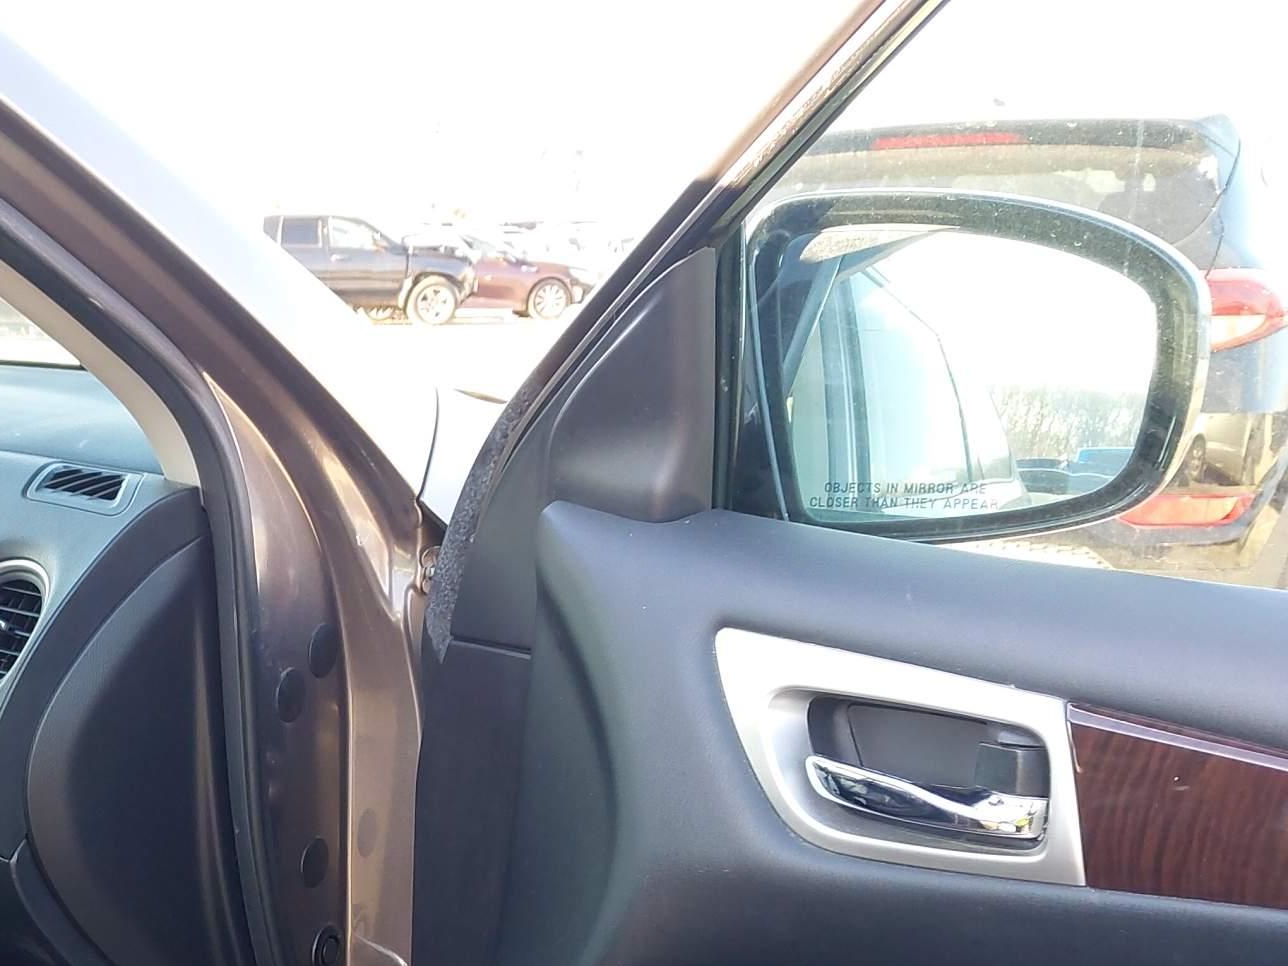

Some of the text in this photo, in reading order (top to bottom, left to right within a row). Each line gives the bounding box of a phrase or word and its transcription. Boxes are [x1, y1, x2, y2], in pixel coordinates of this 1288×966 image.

[824, 482, 987, 494] OBJECTS IN MIRROR ARE
[809, 496, 999, 509] CLOSER THAN THEY APPEAR
